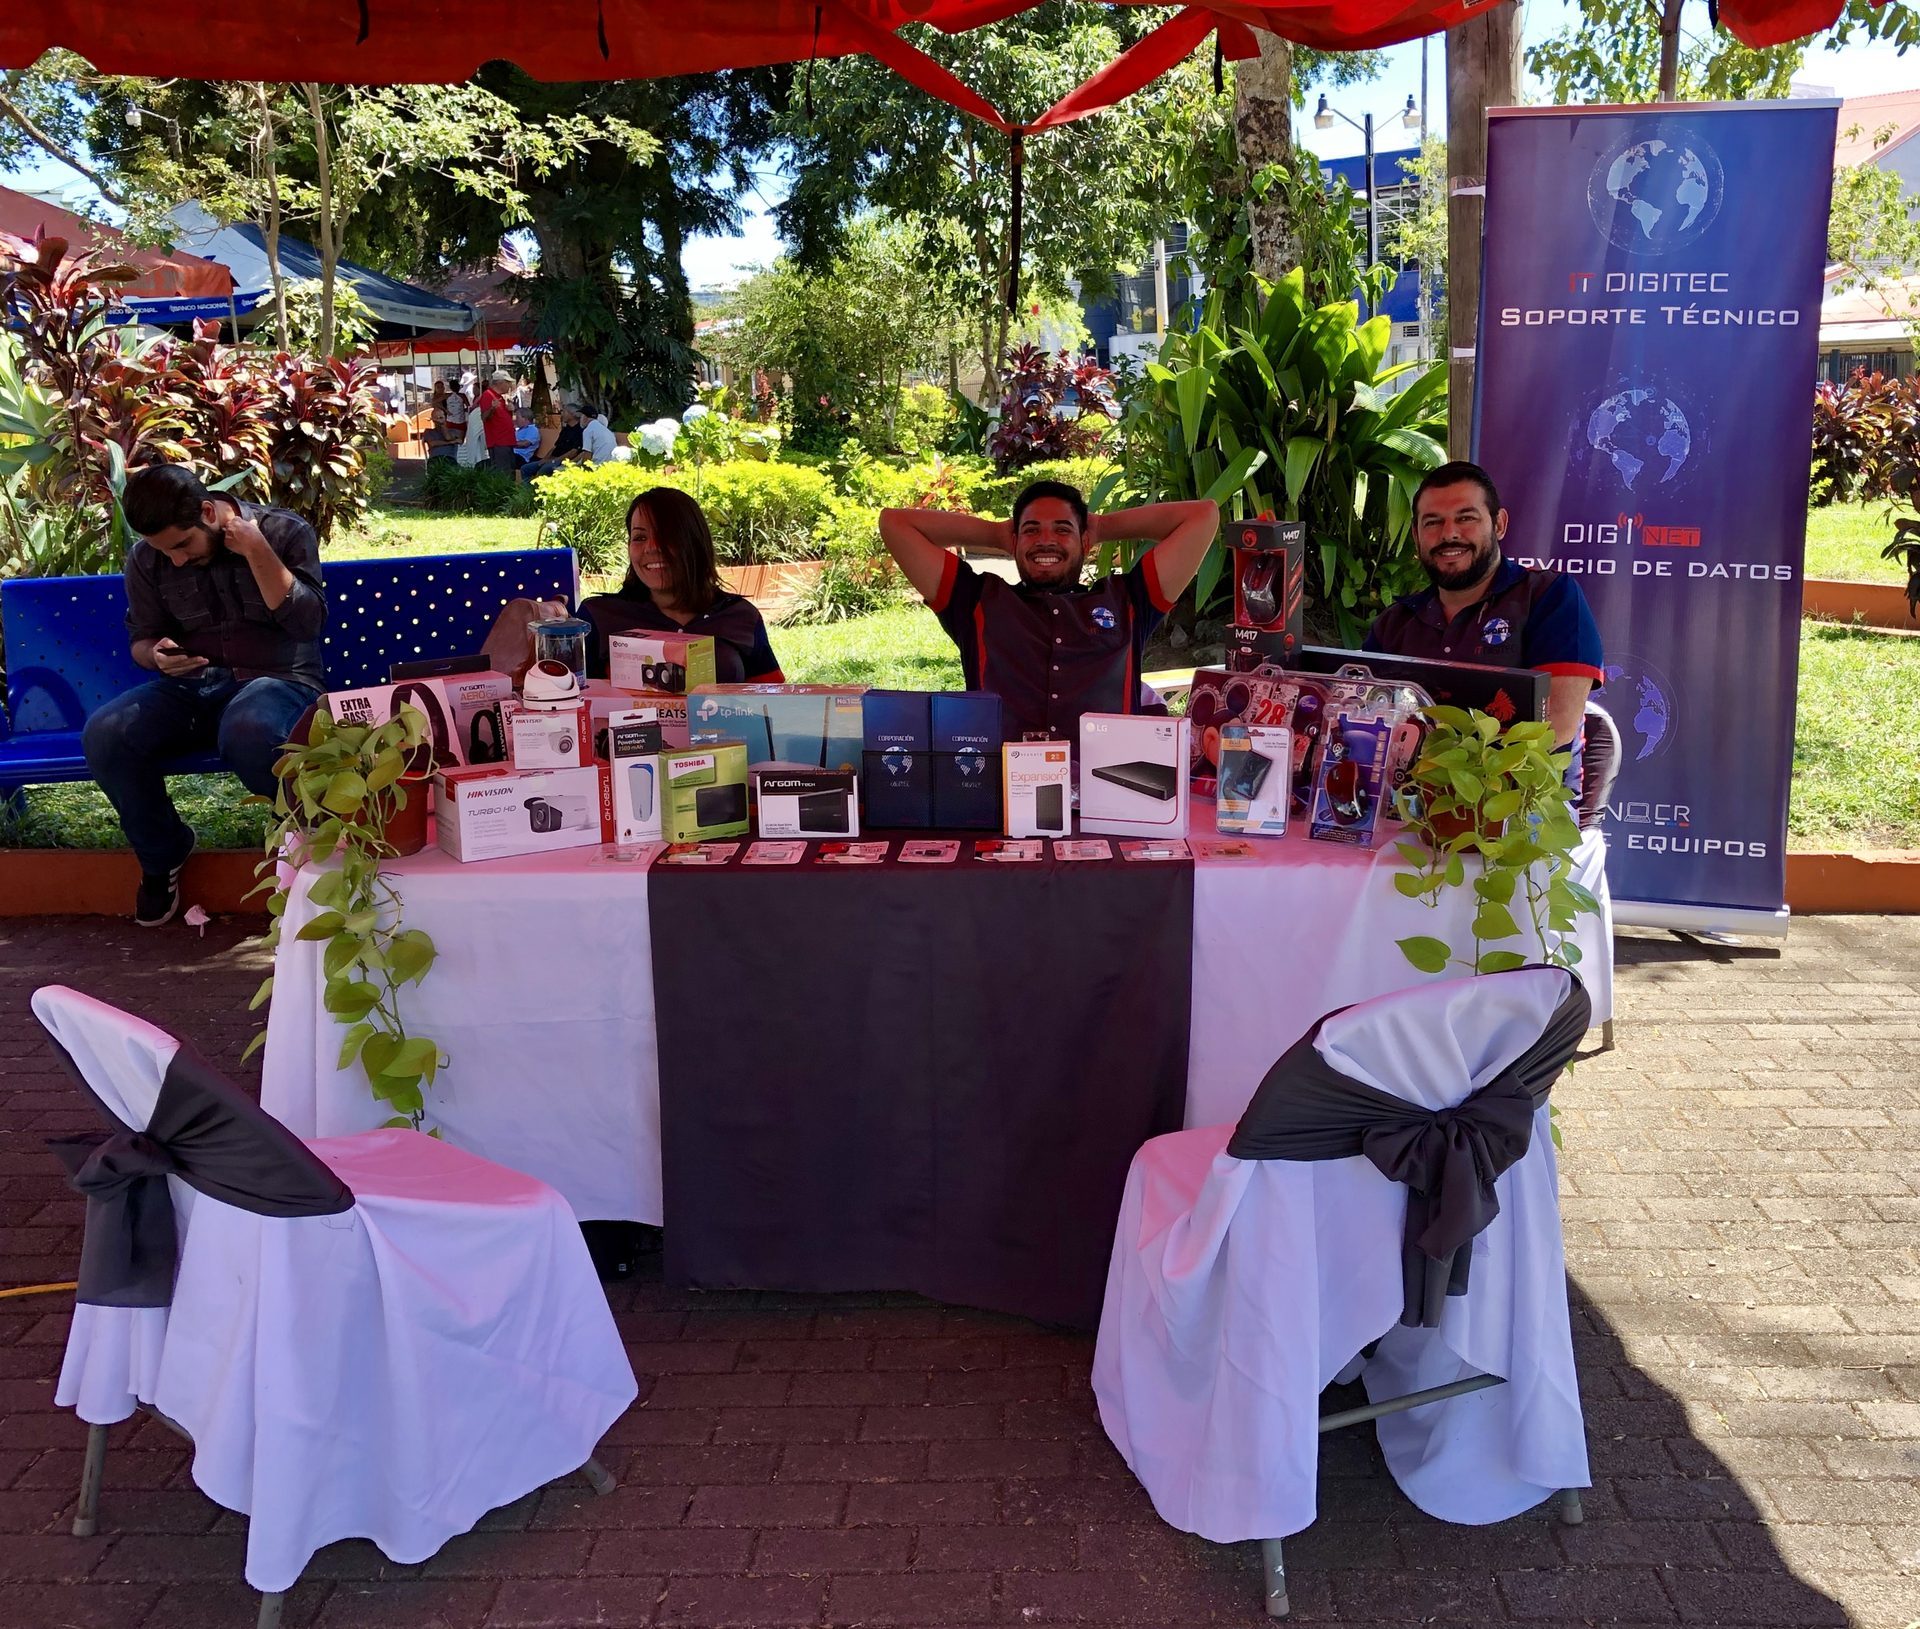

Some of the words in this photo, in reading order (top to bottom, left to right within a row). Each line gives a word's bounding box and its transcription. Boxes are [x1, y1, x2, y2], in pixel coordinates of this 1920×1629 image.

[1569, 272, 1596, 293] IT
[1606, 272, 1729, 293] DIGITEC
[197, 302, 231, 311] NACIONAL
[1500, 307, 1646, 326] SOPORTE
[1660, 302, 1800, 326] TÉCNICO
[1282, 530, 1300, 541] M417
[1506, 558, 1616, 574] RVICIO
[1632, 560, 1672, 576] DE
[1688, 562, 1792, 581] DATOS
[1235, 629, 1258, 641] M417
[340, 697, 372, 712] EXTRA
[632, 701, 686, 710] BAZOOKA
[343, 710, 367, 724] BASS
[656, 708, 687, 719] EATS
[721, 706, 754, 718] tp-link
[1252, 699, 1286, 725] 28
[1096, 724, 1108, 732] LG
[618, 738, 646, 746] Powerbank
[674, 759, 706, 768] TOSHIBA
[1010, 771, 1064, 783] Expansion
[467, 787, 514, 799] HIKVISION
[467, 807, 501, 817] TURBO
[503, 805, 517, 813] HD
[604, 808, 611, 821] HD
[1627, 834, 1767, 858] EQUIPOS
